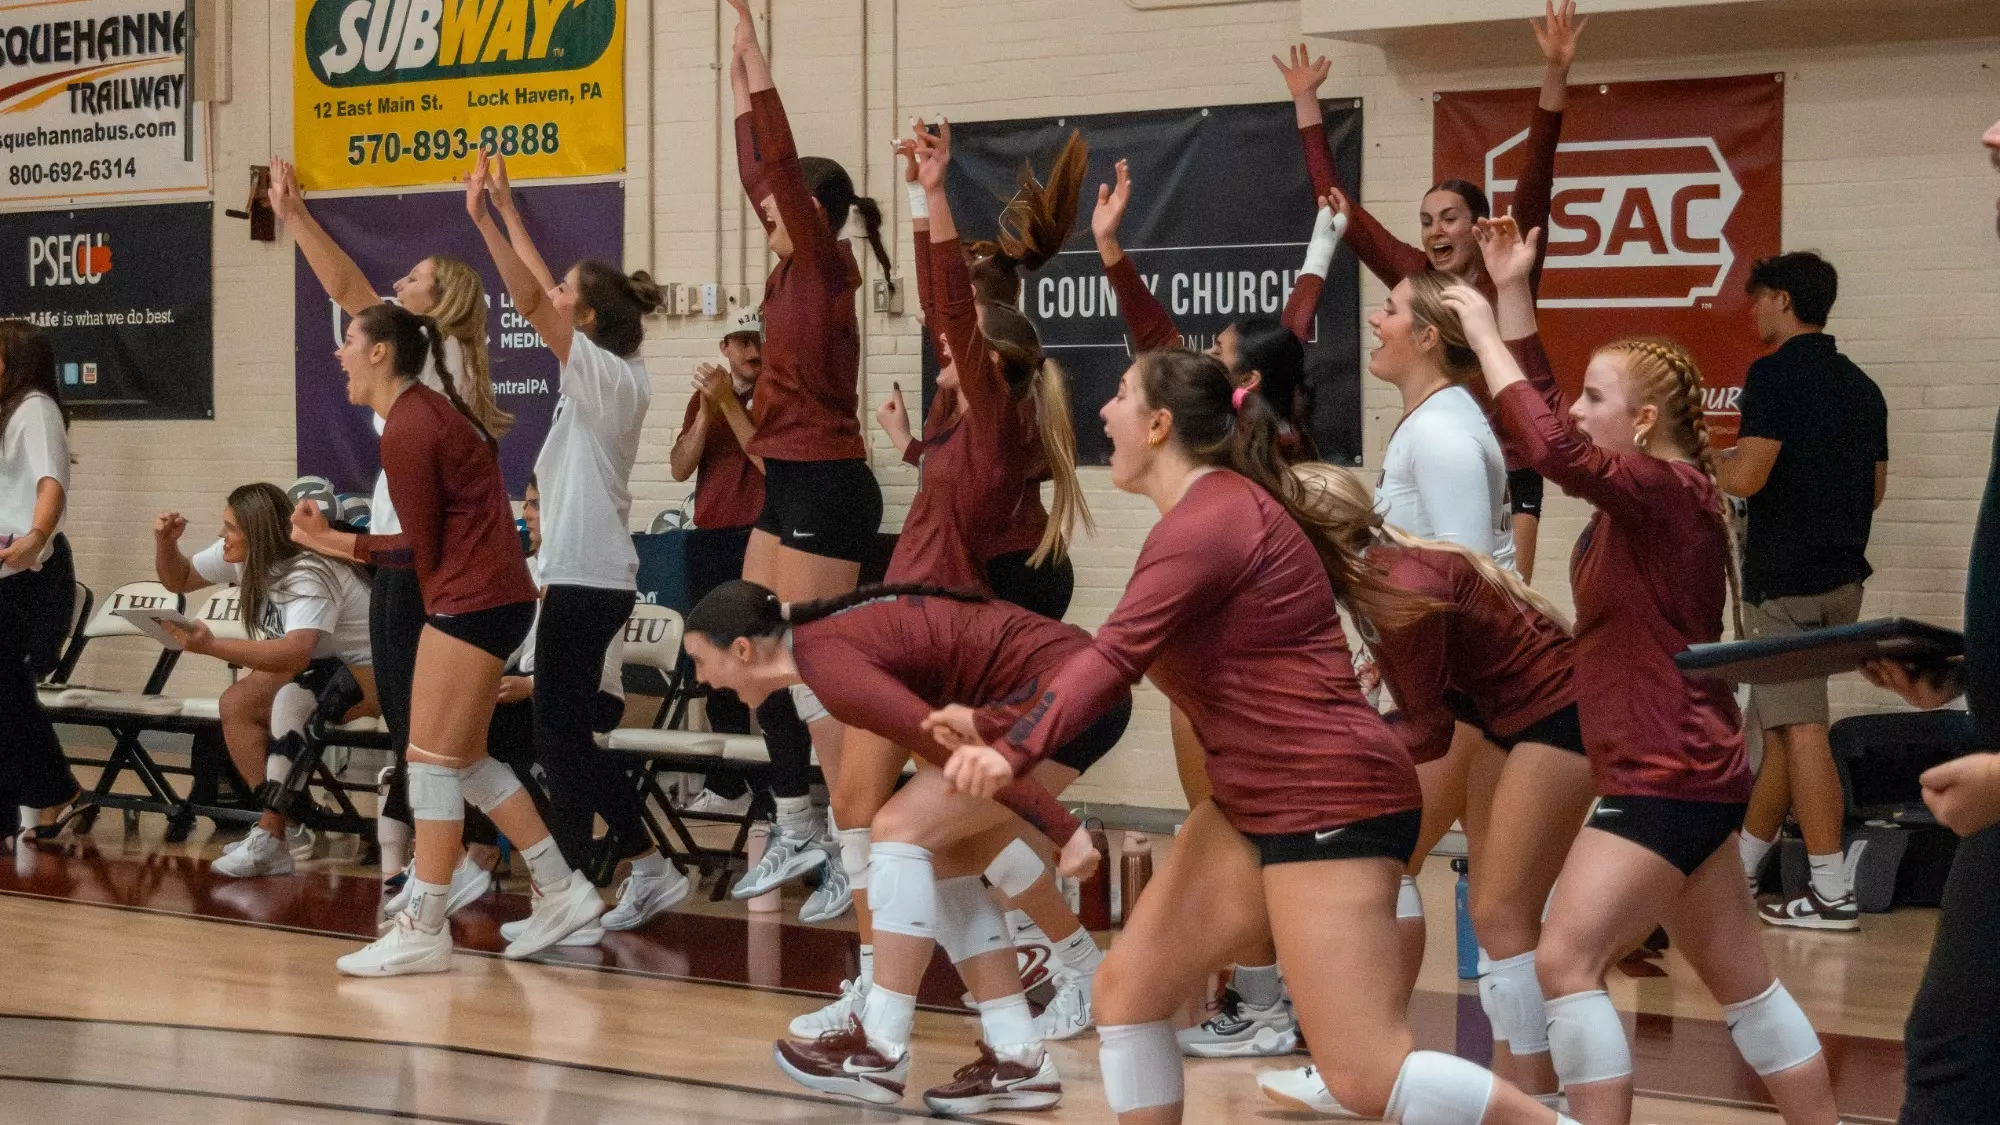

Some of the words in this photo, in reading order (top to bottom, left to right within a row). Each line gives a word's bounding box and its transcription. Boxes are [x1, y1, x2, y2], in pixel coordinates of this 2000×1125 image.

[0, 10, 186, 66] QUEHANNA
[314, 102, 332, 118] 12
[337, 100, 372, 116] East
[378, 97, 415, 113] Main
[421, 95, 443, 111] St.
[468, 89, 508, 108] Lock
[515, 85, 574, 105] Haven,
[581, 82, 601, 100] PA
[0, 121, 176, 153] quehannabus.com
[348, 122, 560, 166] 570-893-8888
[9, 157, 136, 185] 800-692-6314
[29, 232, 103, 287] PSECU
[63, 311, 73, 326] is
[75, 310, 103, 326] what
[106, 313, 124, 325] we
[127, 309, 144, 325] do
[146, 308, 174, 324] best.
[205, 598, 240, 621] LH
[624, 618, 671, 643] HU
